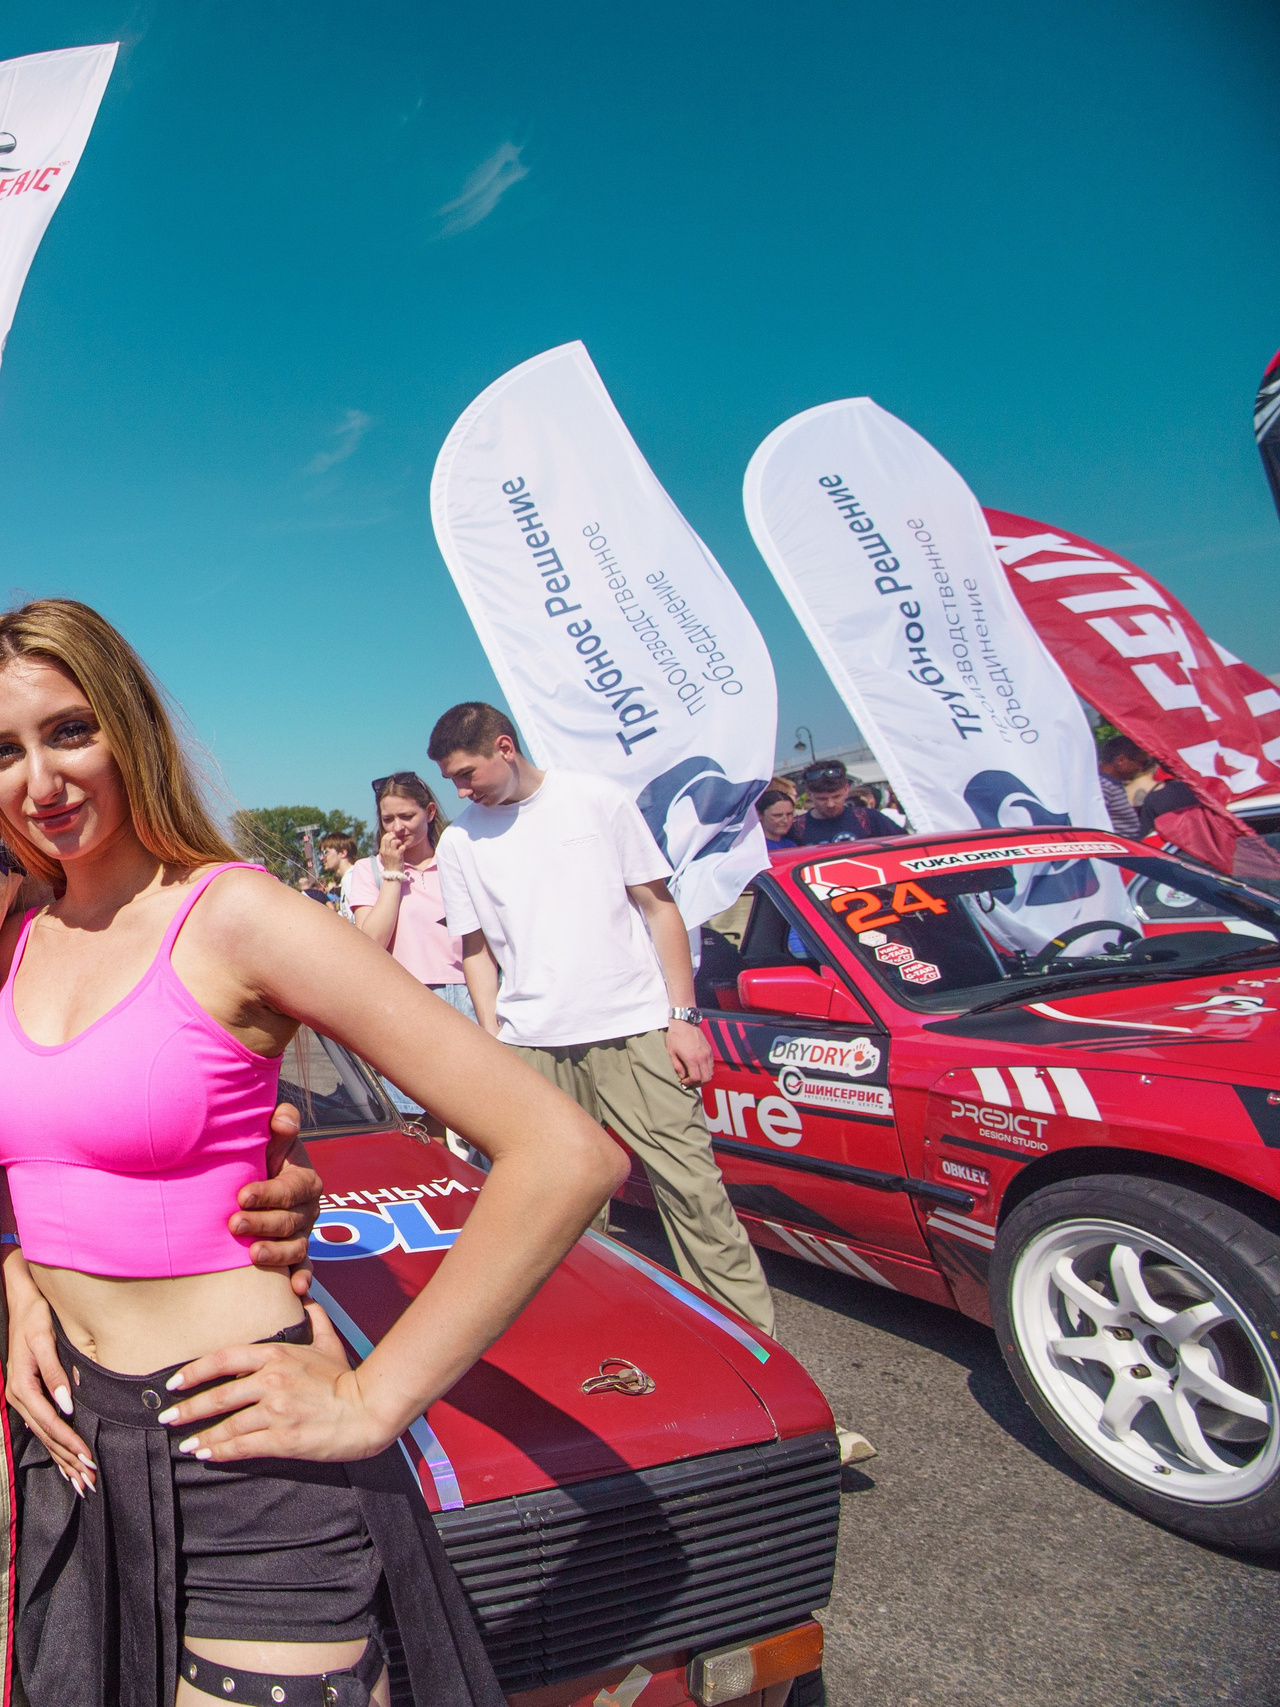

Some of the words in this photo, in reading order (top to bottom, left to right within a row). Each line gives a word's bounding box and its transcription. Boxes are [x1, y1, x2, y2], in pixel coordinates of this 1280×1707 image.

[501, 476, 582, 618] Решение
[818, 474, 913, 595] Решение
[582, 521, 707, 717] производственное
[646, 570, 743, 696] объединение
[899, 600, 983, 740] Трубное
[963, 578, 1039, 744] объединение
[566, 618, 659, 756] Трубное
[830, 881, 949, 934] 24
[908, 855, 962, 870] YUKA
[963, 848, 1026, 863] DRIVE
[1027, 843, 1116, 855] GYMKHANA
[772, 1041, 852, 1066] DRYDRY
[804, 1083, 884, 1105] ШИНСЕРВИС
[979, 1128, 1012, 1143] DESIGN
[1012, 1135, 1049, 1152] STUDIO
